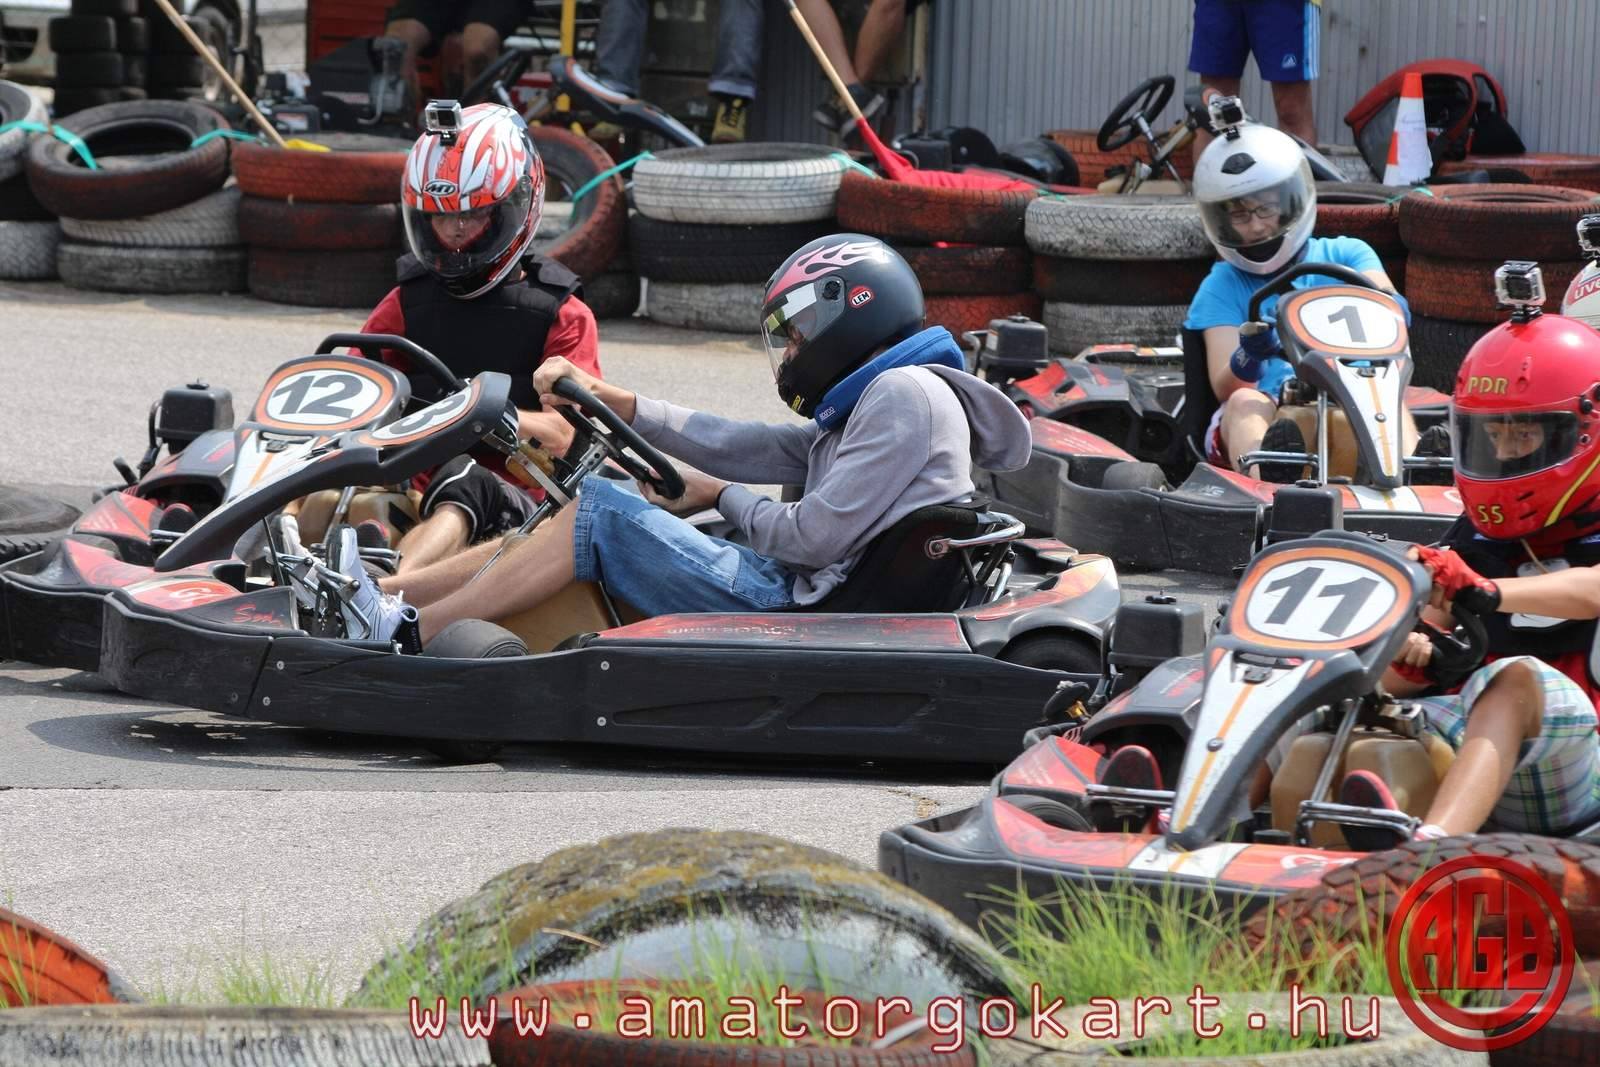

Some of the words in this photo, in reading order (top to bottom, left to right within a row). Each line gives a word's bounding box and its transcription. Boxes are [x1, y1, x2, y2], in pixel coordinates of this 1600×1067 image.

[852, 291, 870, 305] LEM
[1328, 305, 1367, 343] 1
[273, 374, 363, 418] 12
[1467, 376, 1509, 395] PDR
[1263, 566, 1380, 638] 11
